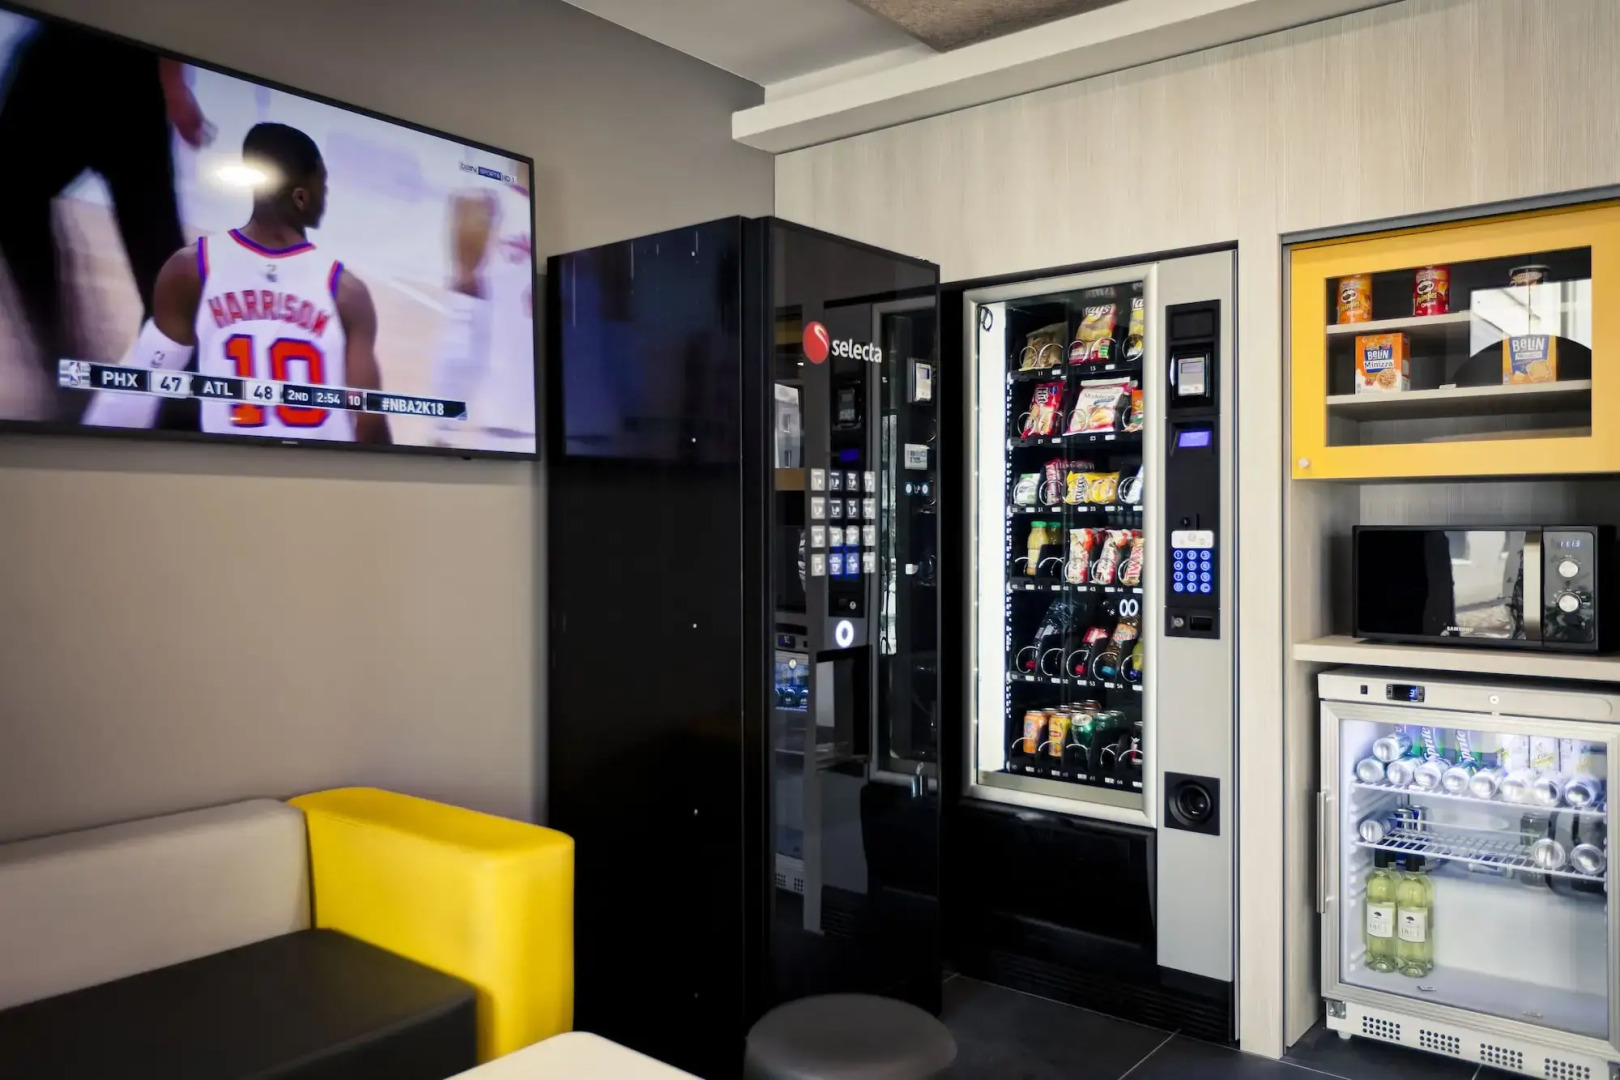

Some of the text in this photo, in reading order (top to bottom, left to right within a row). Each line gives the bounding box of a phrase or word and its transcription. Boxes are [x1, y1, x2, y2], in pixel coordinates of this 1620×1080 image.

[208, 289, 330, 338] HARRISON
[831, 338, 882, 363] selecta
[102, 370, 445, 416] PHX 47 ATL 48 2ND 2:54 10 #NBA2K18
[224, 334, 331, 429] 10
[1456, 730, 1475, 762] prite
